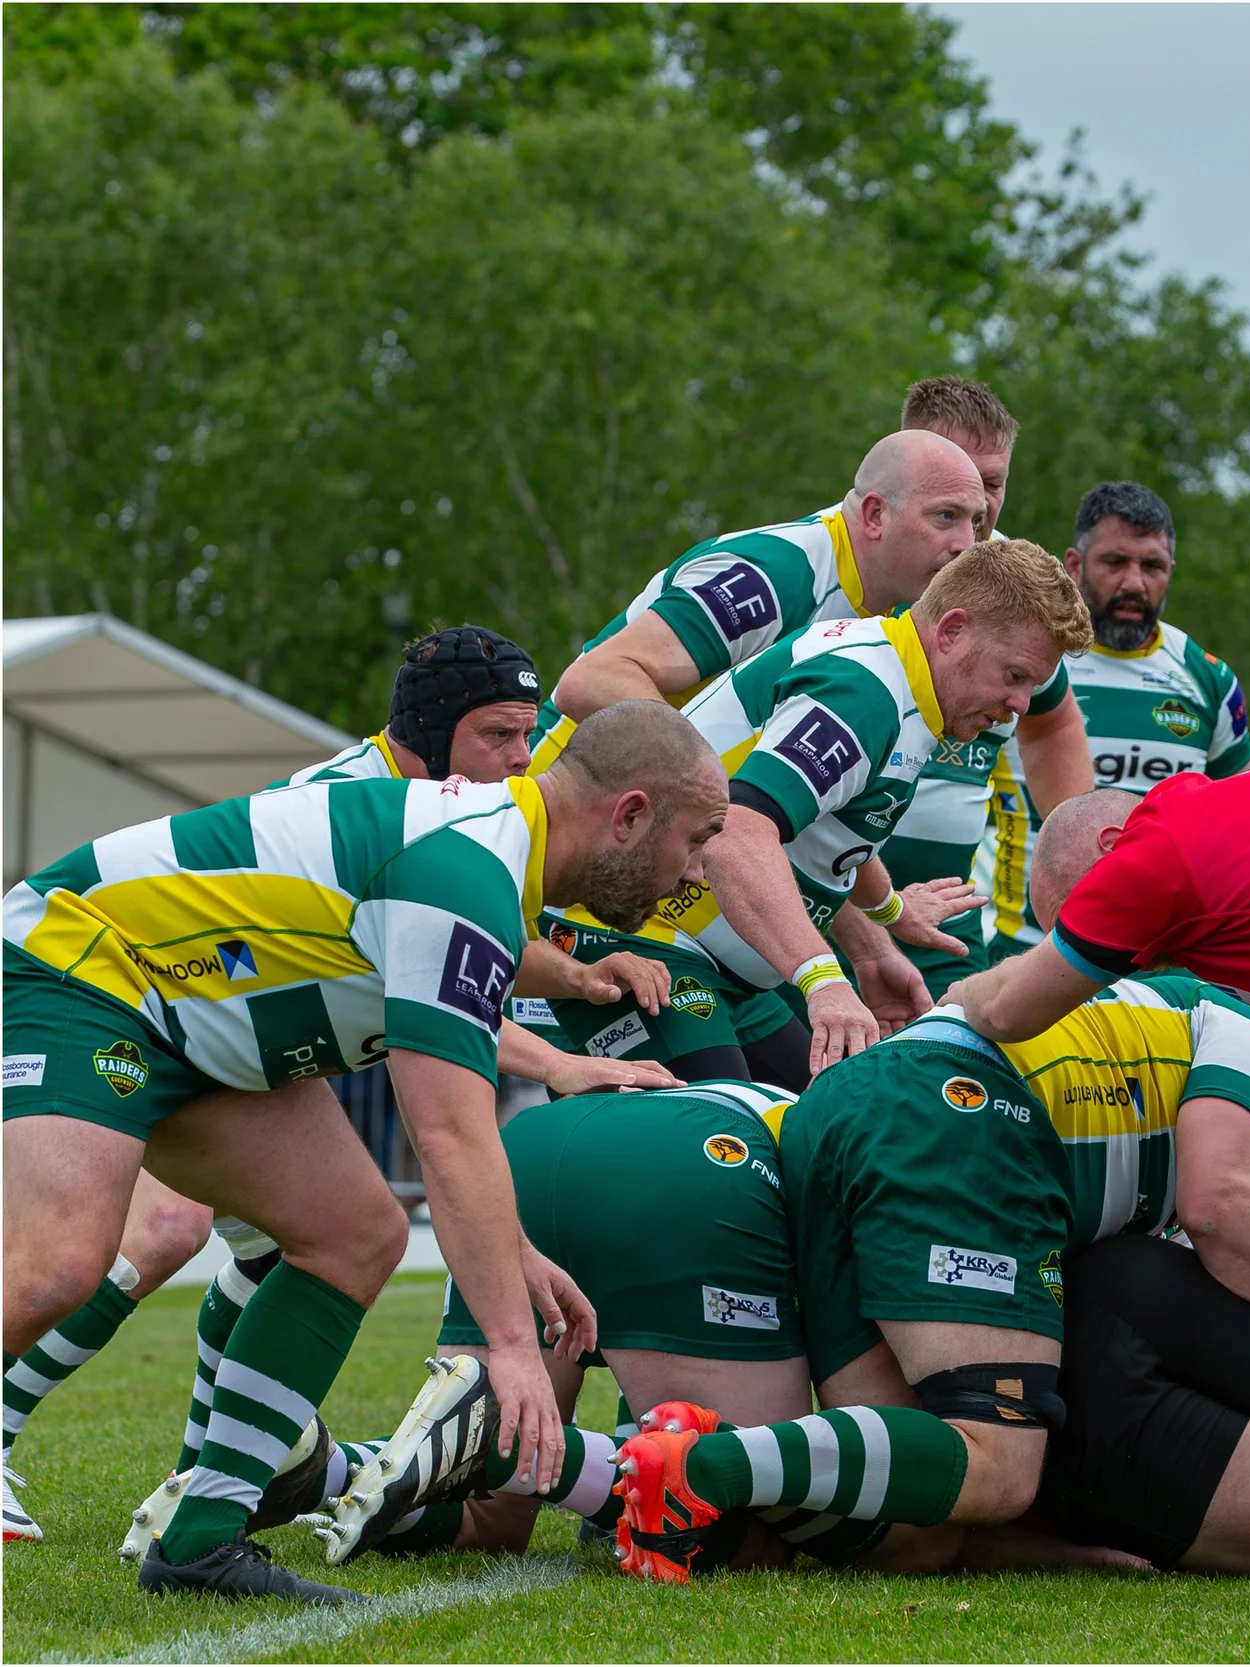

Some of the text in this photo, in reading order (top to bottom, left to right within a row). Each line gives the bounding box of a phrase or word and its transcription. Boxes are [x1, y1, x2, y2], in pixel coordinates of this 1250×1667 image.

[712, 586, 741, 625] LEAPFROG
[720, 572, 766, 618] LF
[799, 721, 849, 764] LF
[794, 741, 830, 777] LEAPFROG
[1093, 744, 1193, 784] gier
[458, 943, 506, 996] LF
[672, 991, 714, 1008] RAIDERS
[3, 1061, 44, 1071] ossborough
[3, 1071, 27, 1080] surance
[97, 1059, 145, 1084] RAIDERS
[993, 1099, 1031, 1123] FNB
[994, 1273, 1014, 1282] Global
